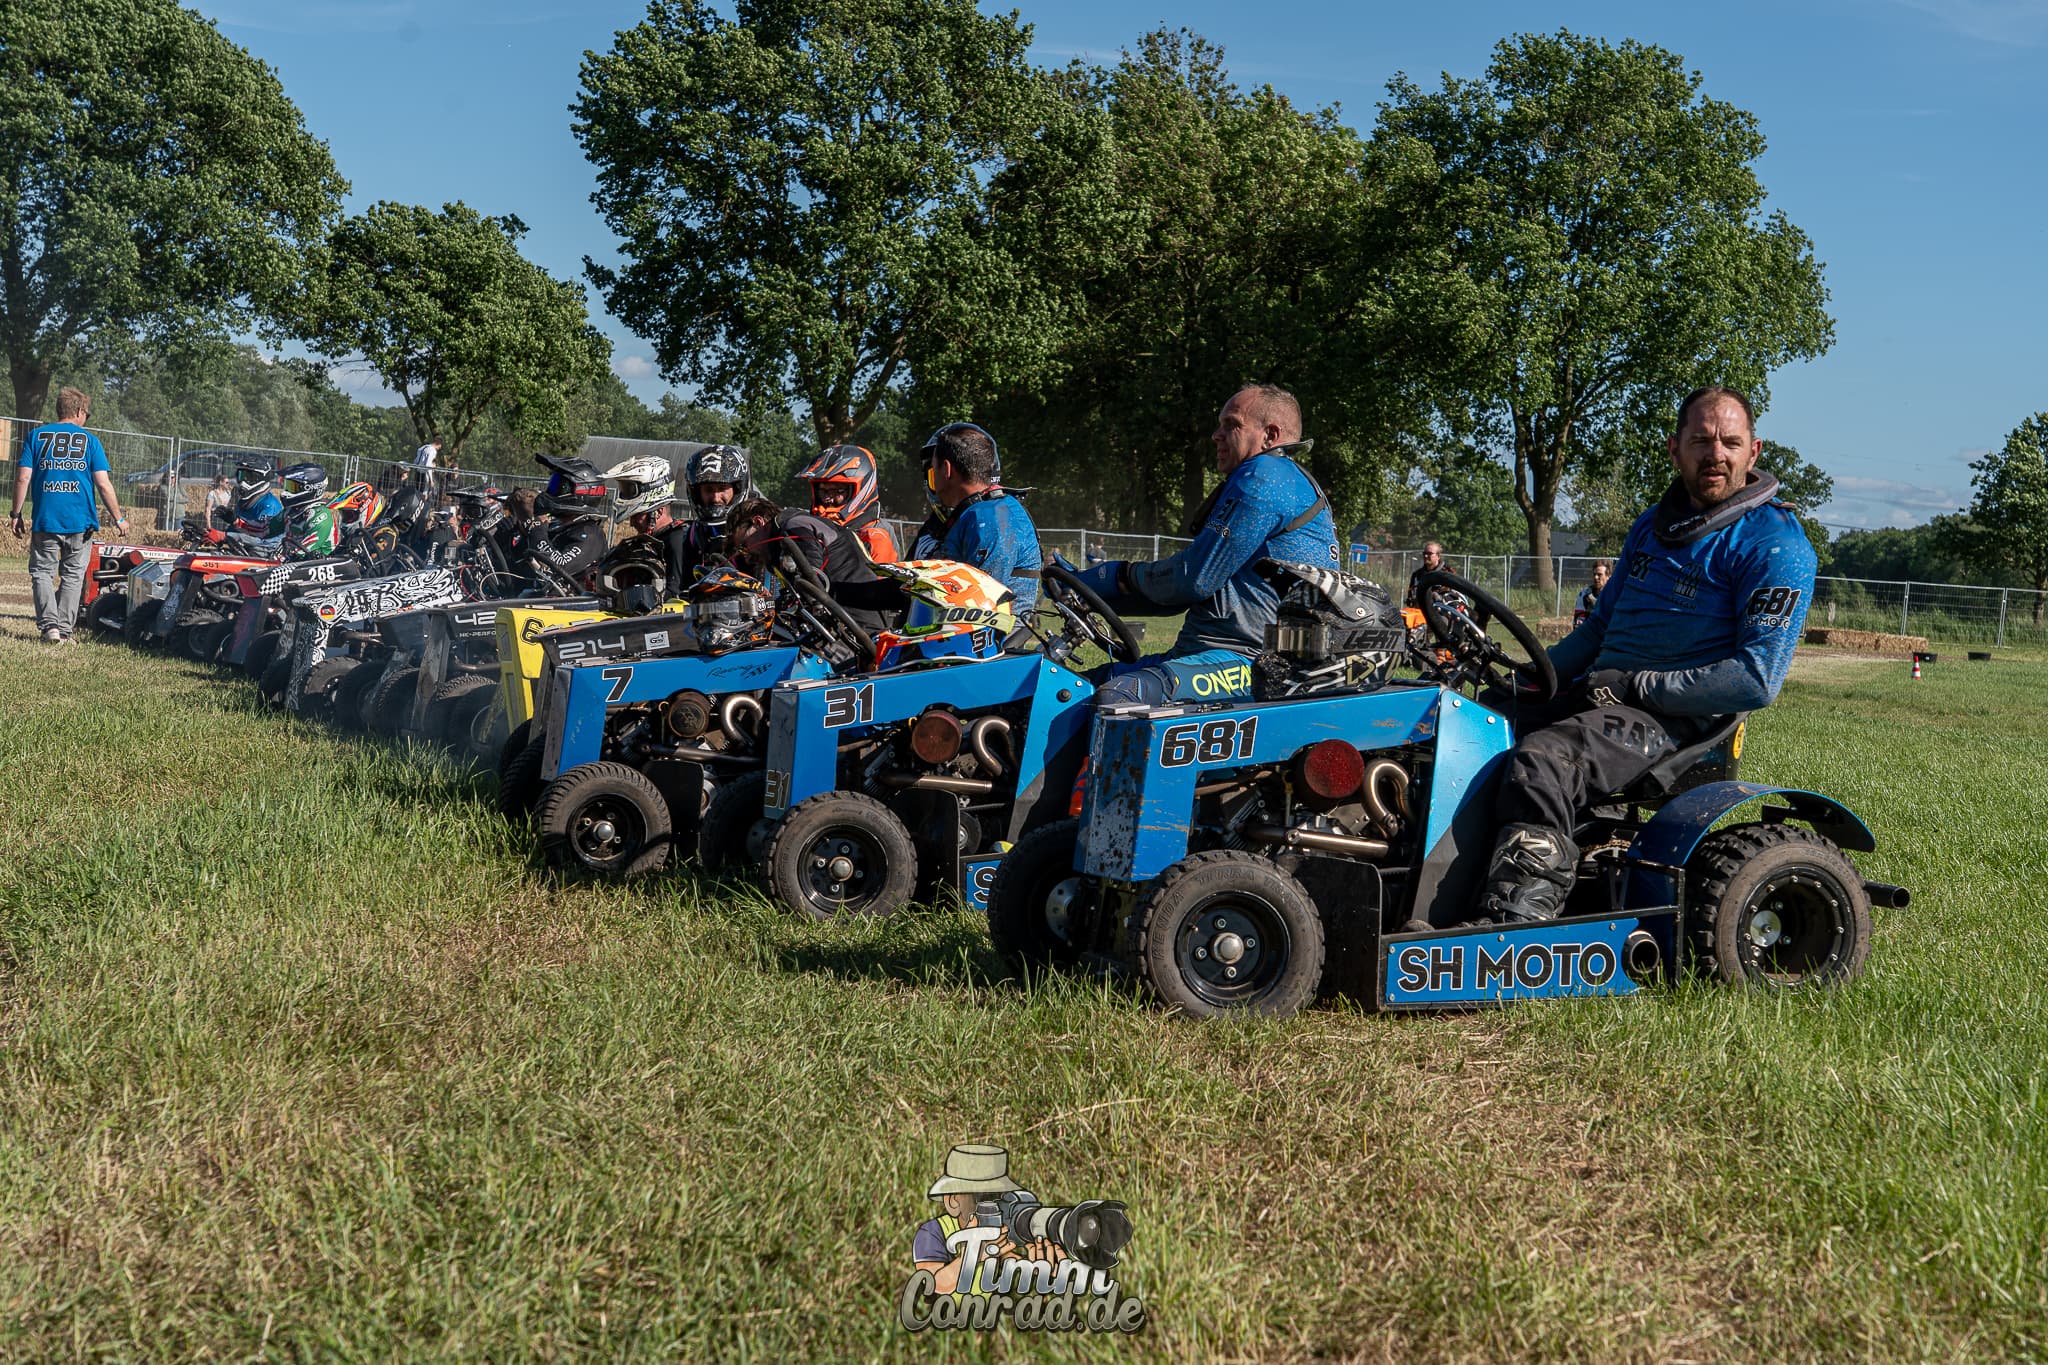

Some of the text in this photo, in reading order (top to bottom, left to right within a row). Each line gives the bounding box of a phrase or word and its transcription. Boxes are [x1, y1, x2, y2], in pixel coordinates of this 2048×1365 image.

[38, 432, 88, 460] 789
[55, 460, 87, 471] MOTO
[43, 481, 80, 492] MARK
[308, 566, 336, 582] 268
[1746, 586, 1802, 618] 681
[937, 607, 999, 626] 100%
[558, 636, 625, 660] 214
[972, 629, 994, 654] 31
[1343, 629, 1402, 650] LEATT
[602, 667, 633, 703] 7
[824, 683, 874, 729] 31
[1159, 716, 1259, 769] 681
[765, 770, 790, 810] 31
[1397, 942, 1617, 993] SH MOTO
